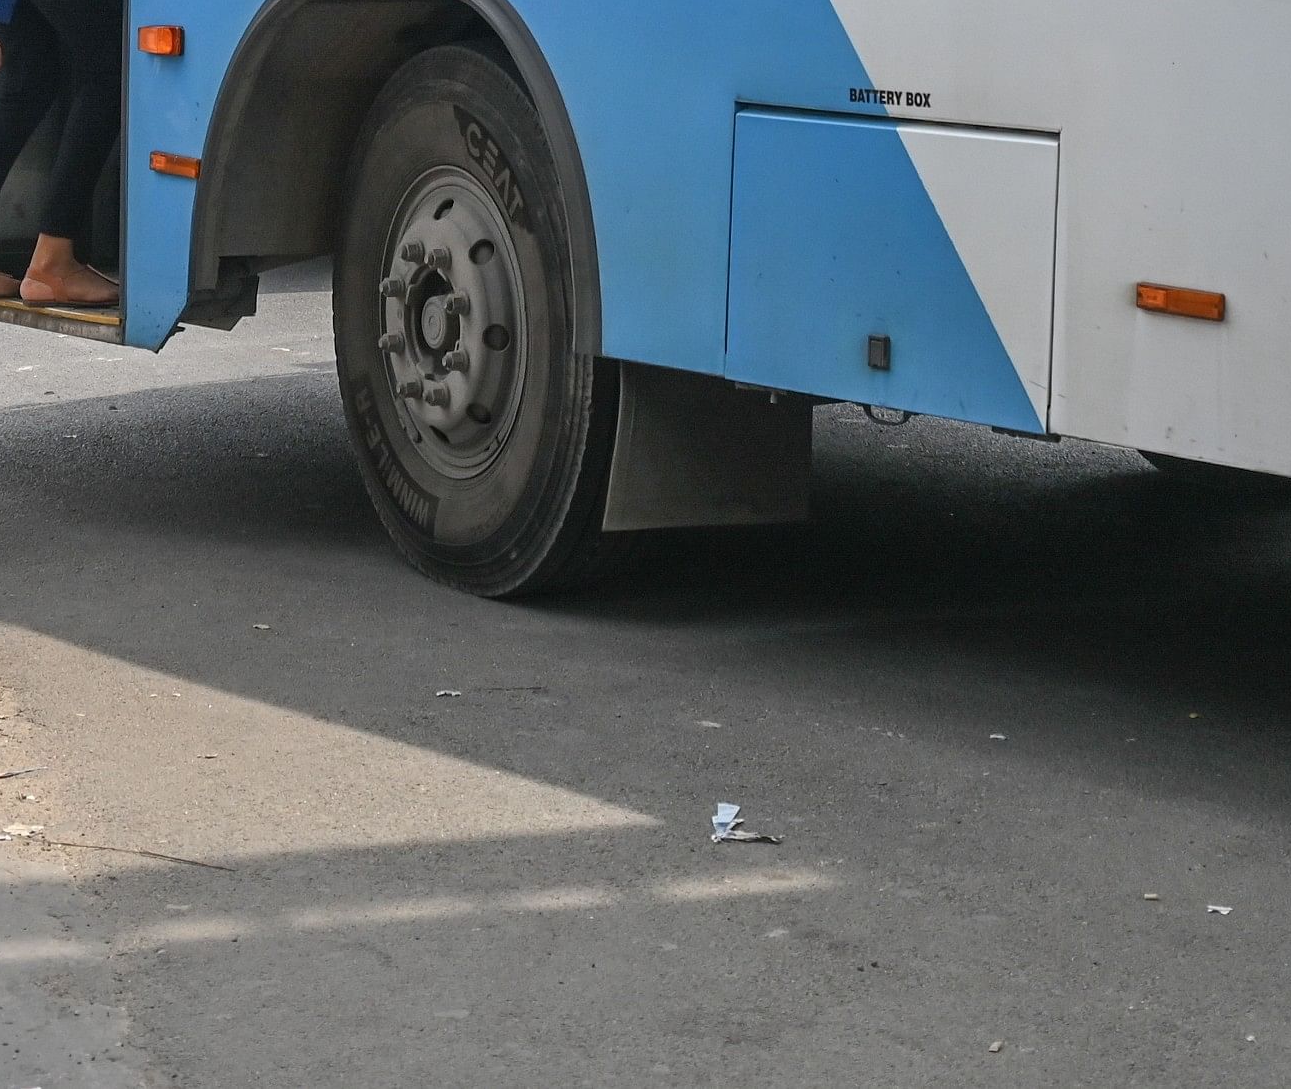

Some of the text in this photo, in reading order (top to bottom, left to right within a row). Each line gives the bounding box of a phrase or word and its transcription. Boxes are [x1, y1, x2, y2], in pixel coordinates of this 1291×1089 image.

[849, 87, 931, 108] BATTERY BOX
[466, 122, 525, 219] CEAT
